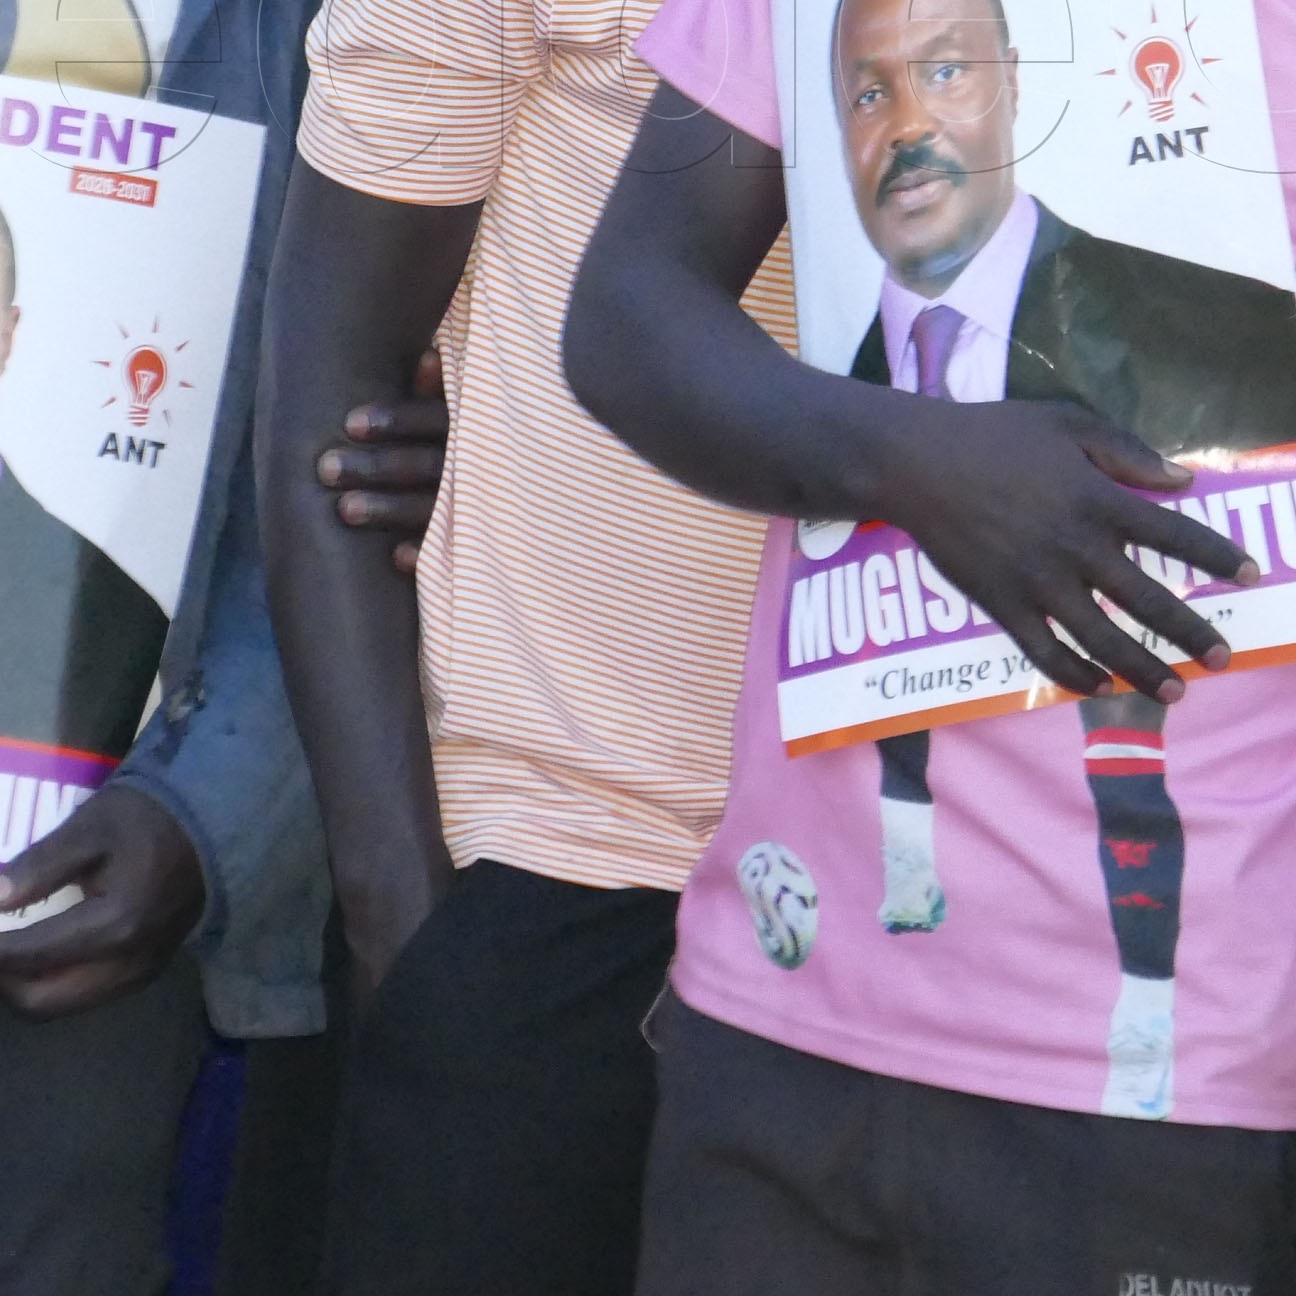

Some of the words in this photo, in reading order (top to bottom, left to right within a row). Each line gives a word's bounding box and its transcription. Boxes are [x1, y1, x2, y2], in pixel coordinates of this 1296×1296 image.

[1129, 126, 1209, 165] ANT
[97, 432, 166, 468] ANT
[788, 548, 994, 668] MUGIS
[1001, 653, 1036, 684] yo
